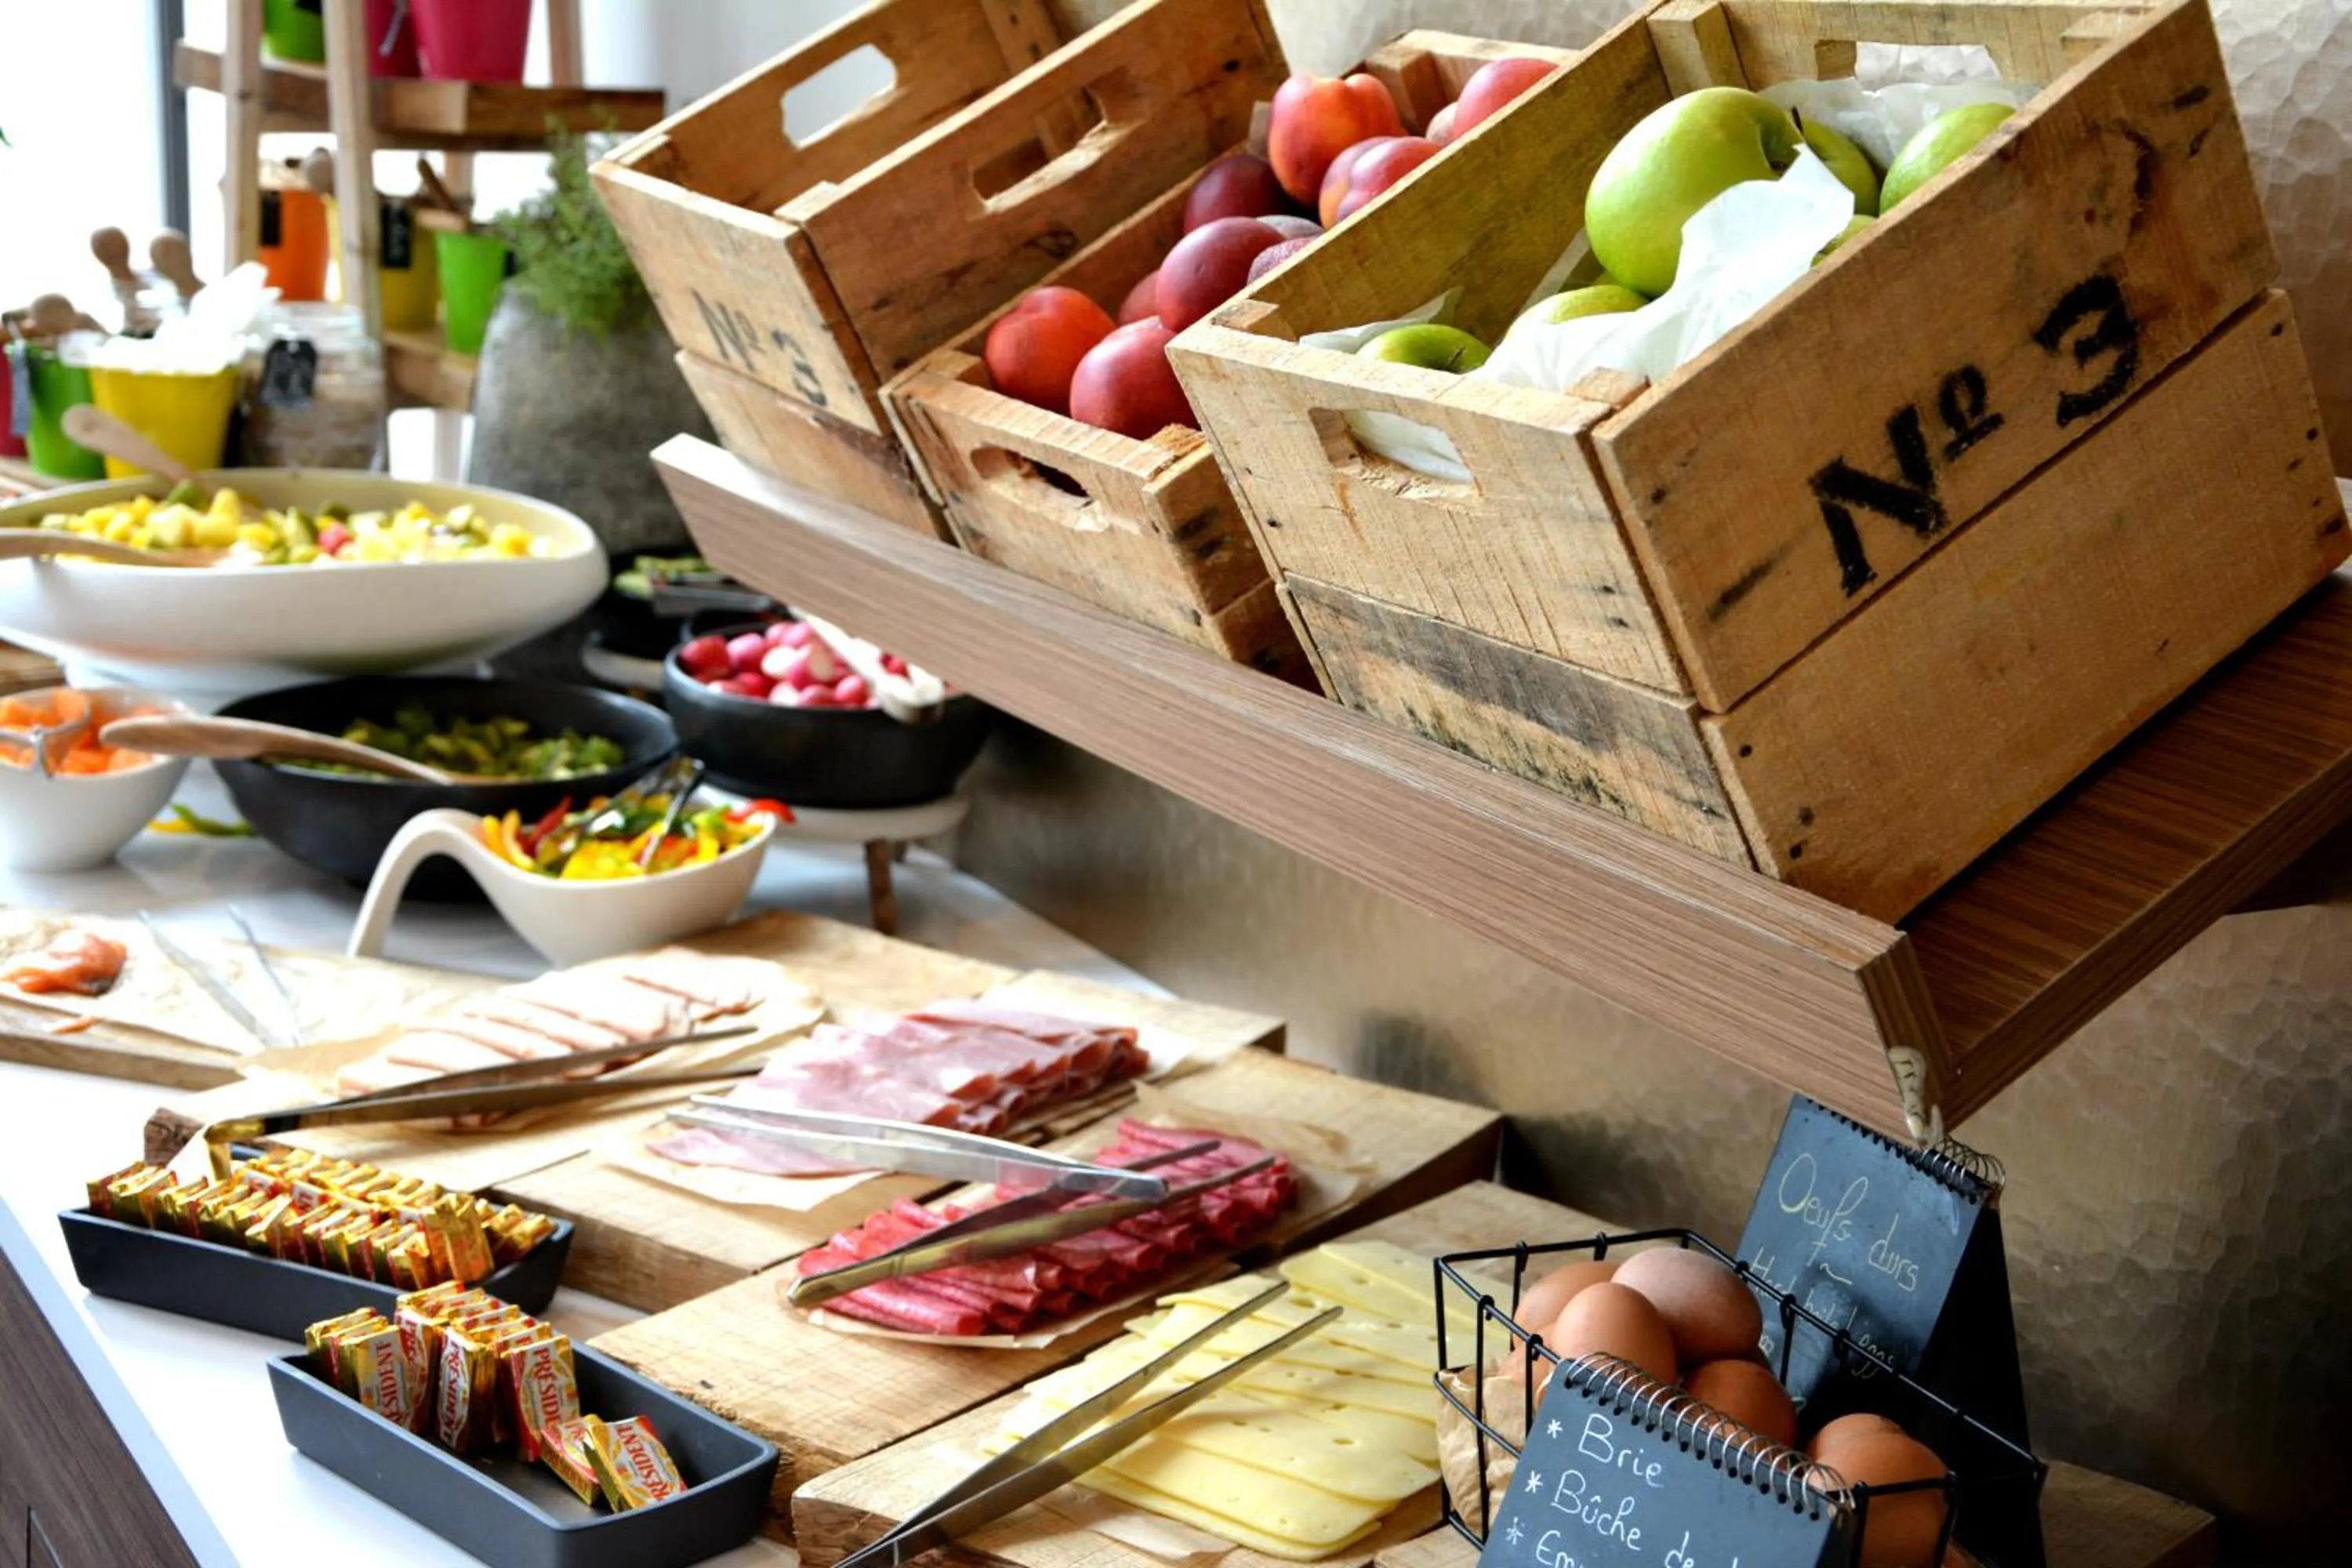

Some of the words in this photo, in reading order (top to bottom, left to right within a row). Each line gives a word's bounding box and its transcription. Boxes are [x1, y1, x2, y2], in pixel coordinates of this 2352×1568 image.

[771, 329, 828, 407] 3
[2034, 274, 2141, 426] 3
[1867, 1214, 1920, 1293] durs
[1577, 1414, 1664, 1488] Brie
[1551, 1470, 1642, 1552] Bûche
